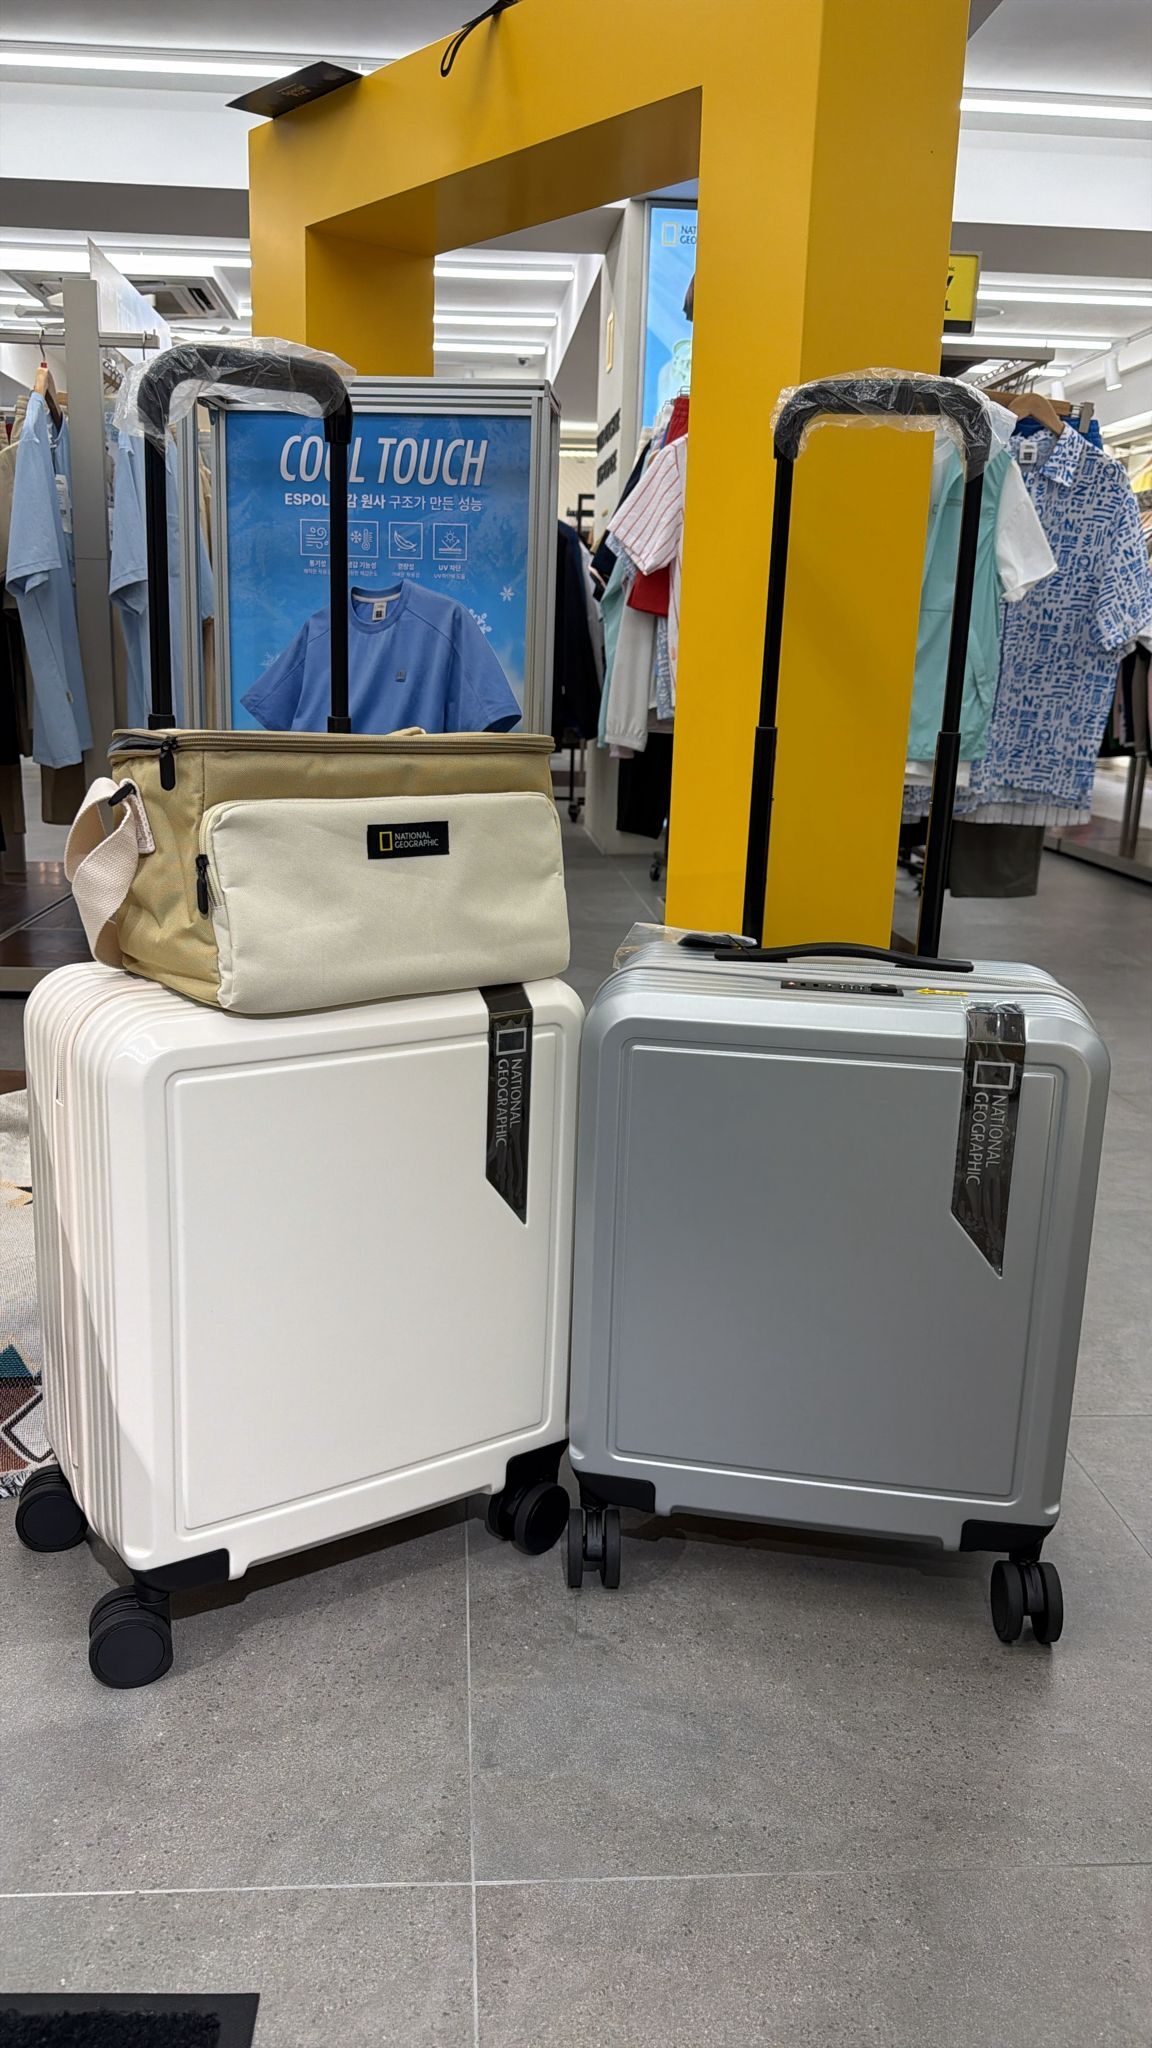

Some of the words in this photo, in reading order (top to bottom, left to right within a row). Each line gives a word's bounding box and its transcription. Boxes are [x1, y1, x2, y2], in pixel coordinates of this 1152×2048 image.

[279, 435, 365, 483] COL
[377, 437, 488, 487] TOUCH
[361, 493, 386, 509] 원사
[389, 495, 426, 510] 구조가
[430, 496, 454, 511] 만든
[458, 496, 483, 512] 성능
[394, 831, 431, 840] NATIONAL
[394, 838, 439, 849] GEOGRAPHIC
[495, 1058, 510, 1148] GEOGRAPHIC
[510, 1058, 523, 1129] NATIONAL
[966, 1091, 989, 1185] GEOGRAPHIC
[985, 1094, 1008, 1168] NATIONAL
